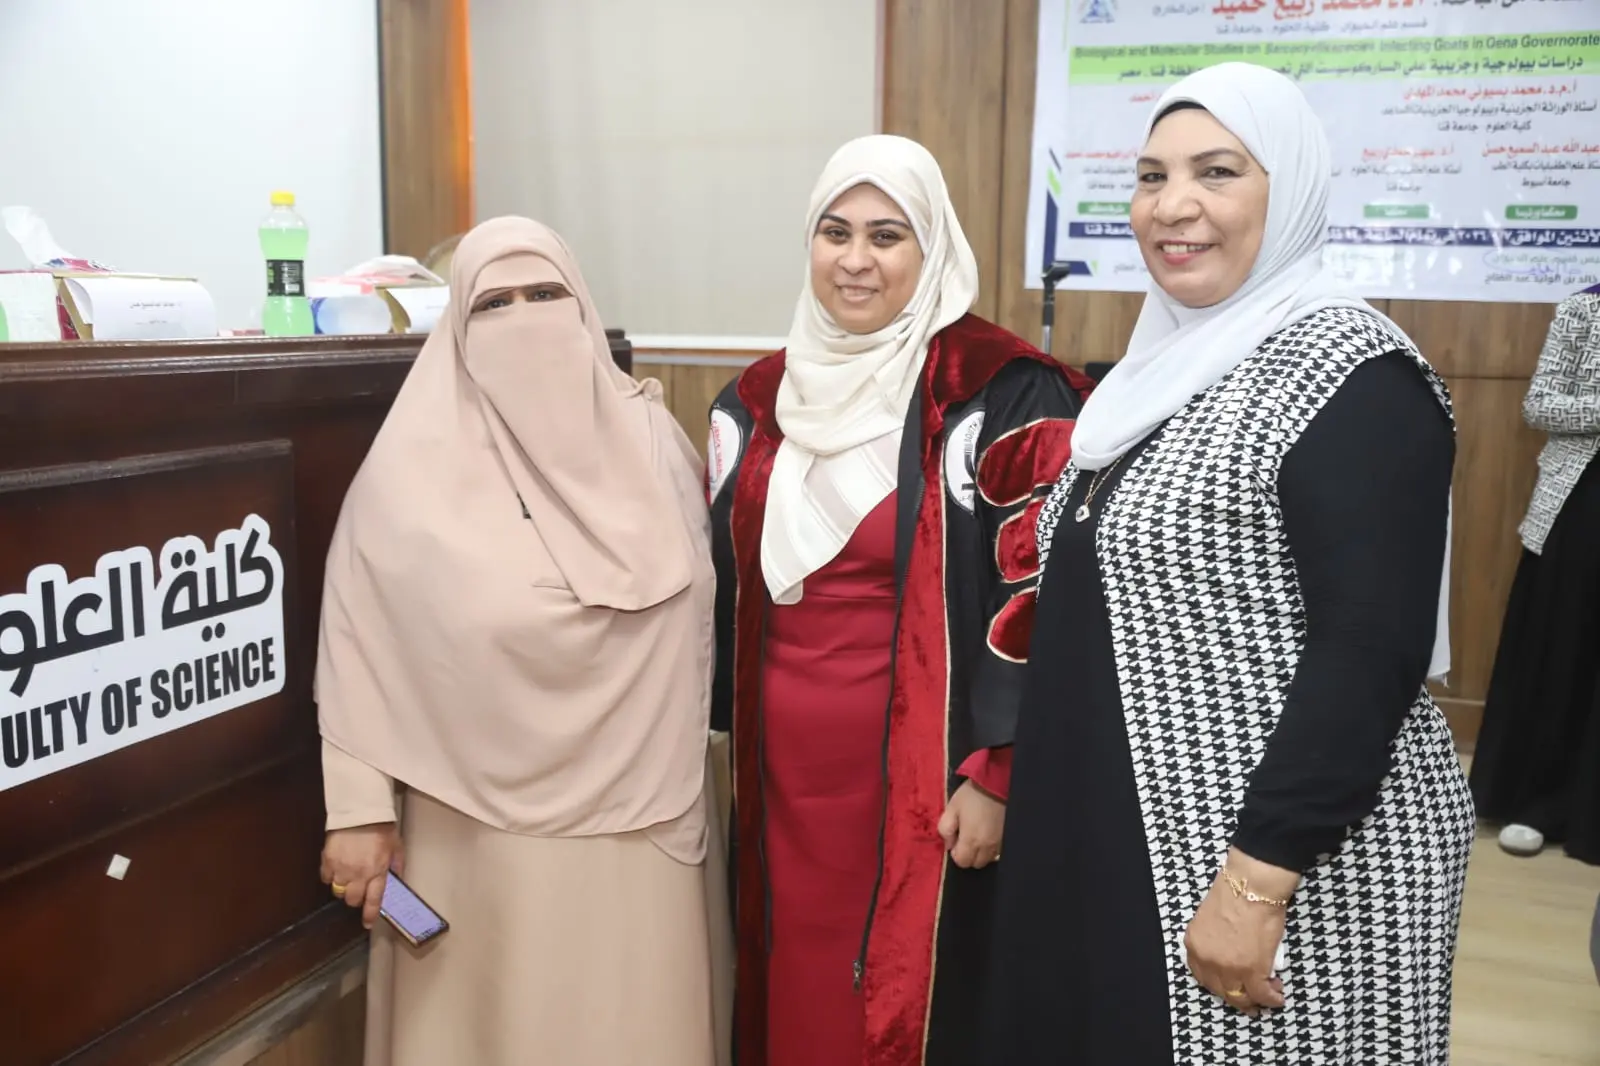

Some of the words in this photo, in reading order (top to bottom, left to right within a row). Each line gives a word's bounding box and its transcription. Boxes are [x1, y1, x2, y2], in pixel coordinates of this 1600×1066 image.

[1128, 45, 1148, 56] and
[1203, 42, 1243, 54] Studies
[1434, 37, 1468, 50] Goats
[1472, 36, 1483, 49] in
[1521, 32, 1600, 48] Governorate
[1482, 56, 1536, 74] بيولوجية
[1537, 54, 1583, 70] دراسات
[1451, 120, 1480, 133] جامعة
[1511, 229, 1556, 246] الموافق
[161, 527, 275, 642] كلية
[0, 691, 92, 768] ULTY
[101, 676, 143, 735] OF
[150, 636, 276, 719] SCIENCE
